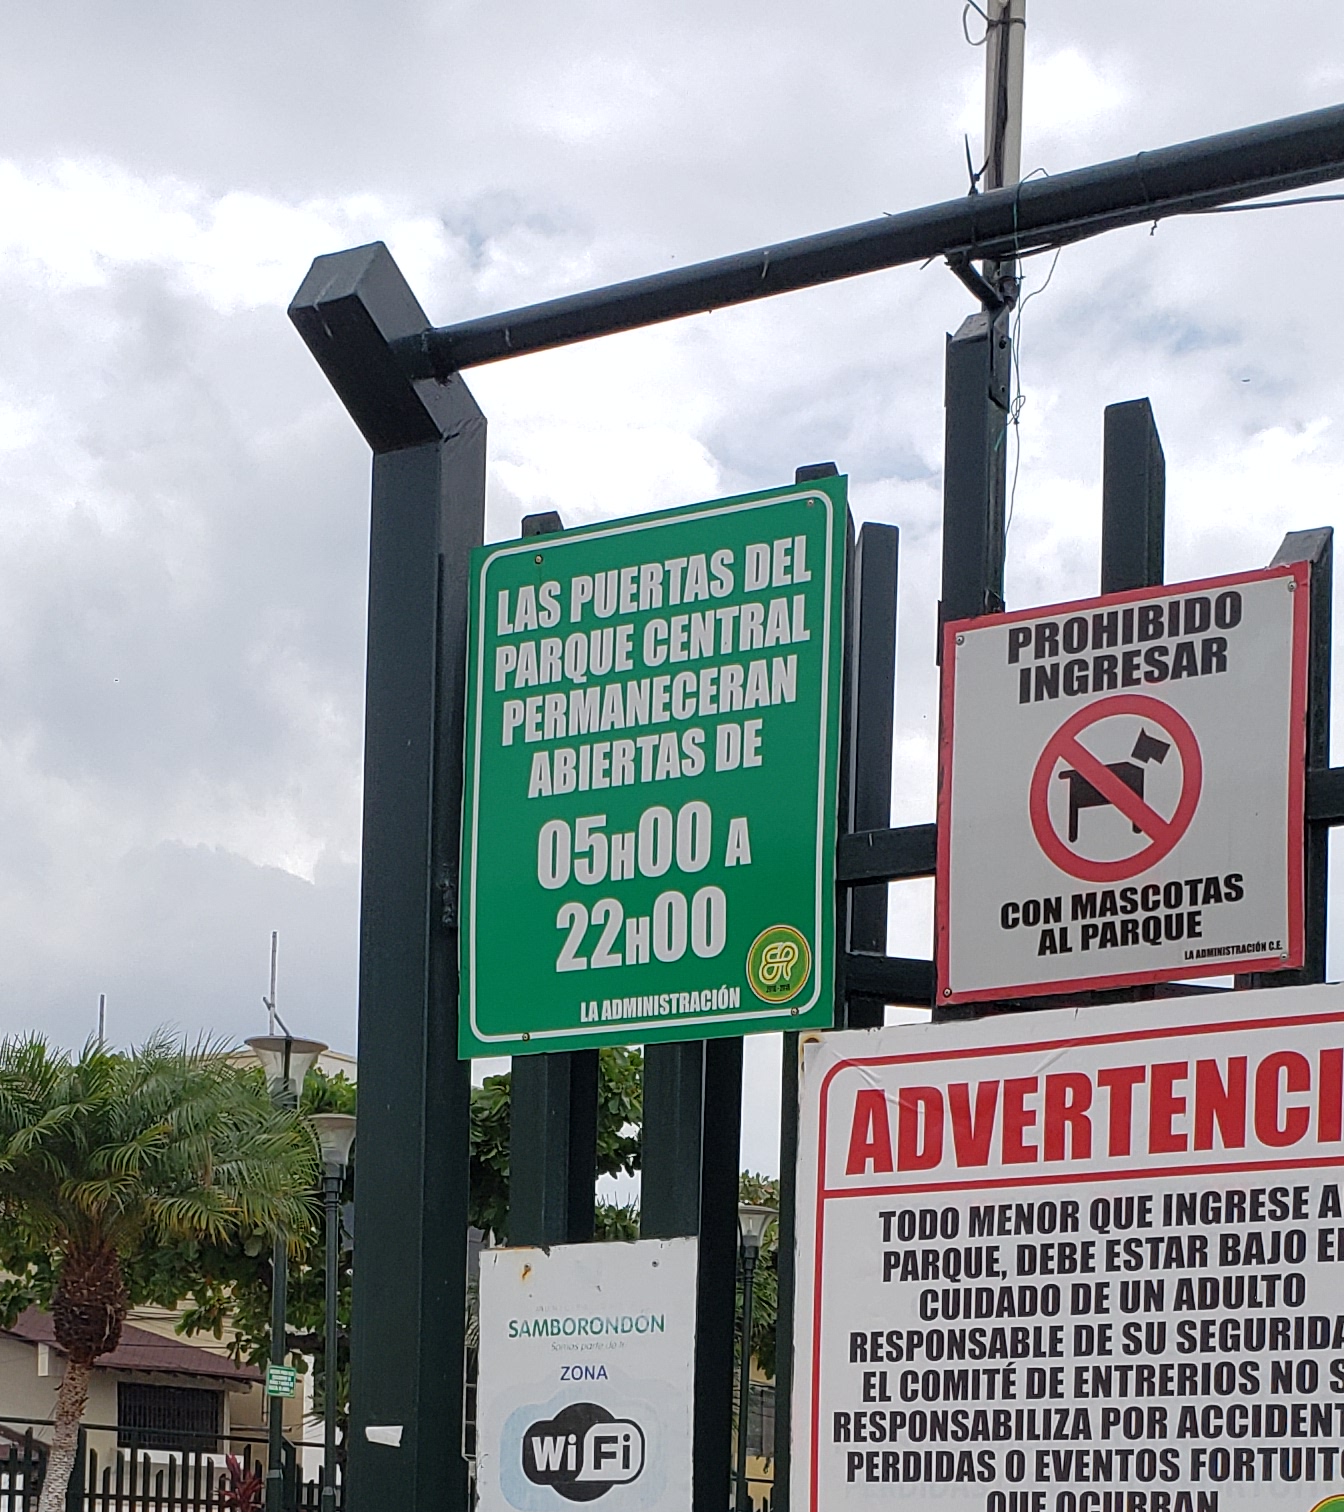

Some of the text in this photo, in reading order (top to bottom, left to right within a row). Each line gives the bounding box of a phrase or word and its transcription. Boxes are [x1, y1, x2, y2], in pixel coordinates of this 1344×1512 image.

[497, 535, 811, 636] LAS PUERTAS DEL
[494, 594, 810, 691] PARQUE CENTRAL
[1007, 590, 1243, 665] PROHIBIDO
[1019, 636, 1228, 704] INGRESAR
[502, 655, 797, 746] PERMANECERAN
[527, 719, 763, 799] ABIERTAS DE
[724, 817, 752, 867] A
[1000, 872, 1245, 930] CON MASCOTAS
[1037, 910, 1203, 957] AL PARQUE
[1184, 949, 1194, 960] LA
[1195, 940, 1266, 959] ADMINISTRACIÓN
[580, 986, 740, 1023] LA ADMINISTRACIÓN
[879, 1206, 960, 1243] TODO
[968, 1200, 1080, 1239] MENOR
[1089, 1194, 1154, 1232] QUE
[1162, 1185, 1309, 1228] INGRESE
[882, 1242, 1008, 1283] PARQUE,
[1016, 1241, 1097, 1278] DEBE
[1105, 1235, 1209, 1274] ESTAR
[1218, 1230, 1307, 1268] BAJO
[918, 1272, 1306, 1322] CUIDADO DE UN ADULTO
[849, 1325, 1064, 1364] RESPONSABLE
[1073, 1323, 1114, 1358] DE
[1122, 1321, 1168, 1357] SU
[560, 1365, 608, 1381] ZONA
[862, 1368, 891, 1403] EL
[898, 1362, 1017, 1403] COMITÉ
[1025, 1365, 1065, 1400] DE
[1073, 1361, 1261, 1399] ENTRERIOS
[1270, 1358, 1321, 1395] NO
[833, 1408, 1092, 1443] RESPONSABILIZA
[1100, 1405, 1168, 1441] POR
[846, 1449, 997, 1483] PERDIDAS
[1004, 1449, 1026, 1482] O
[1034, 1447, 1180, 1482] EVENTOS
